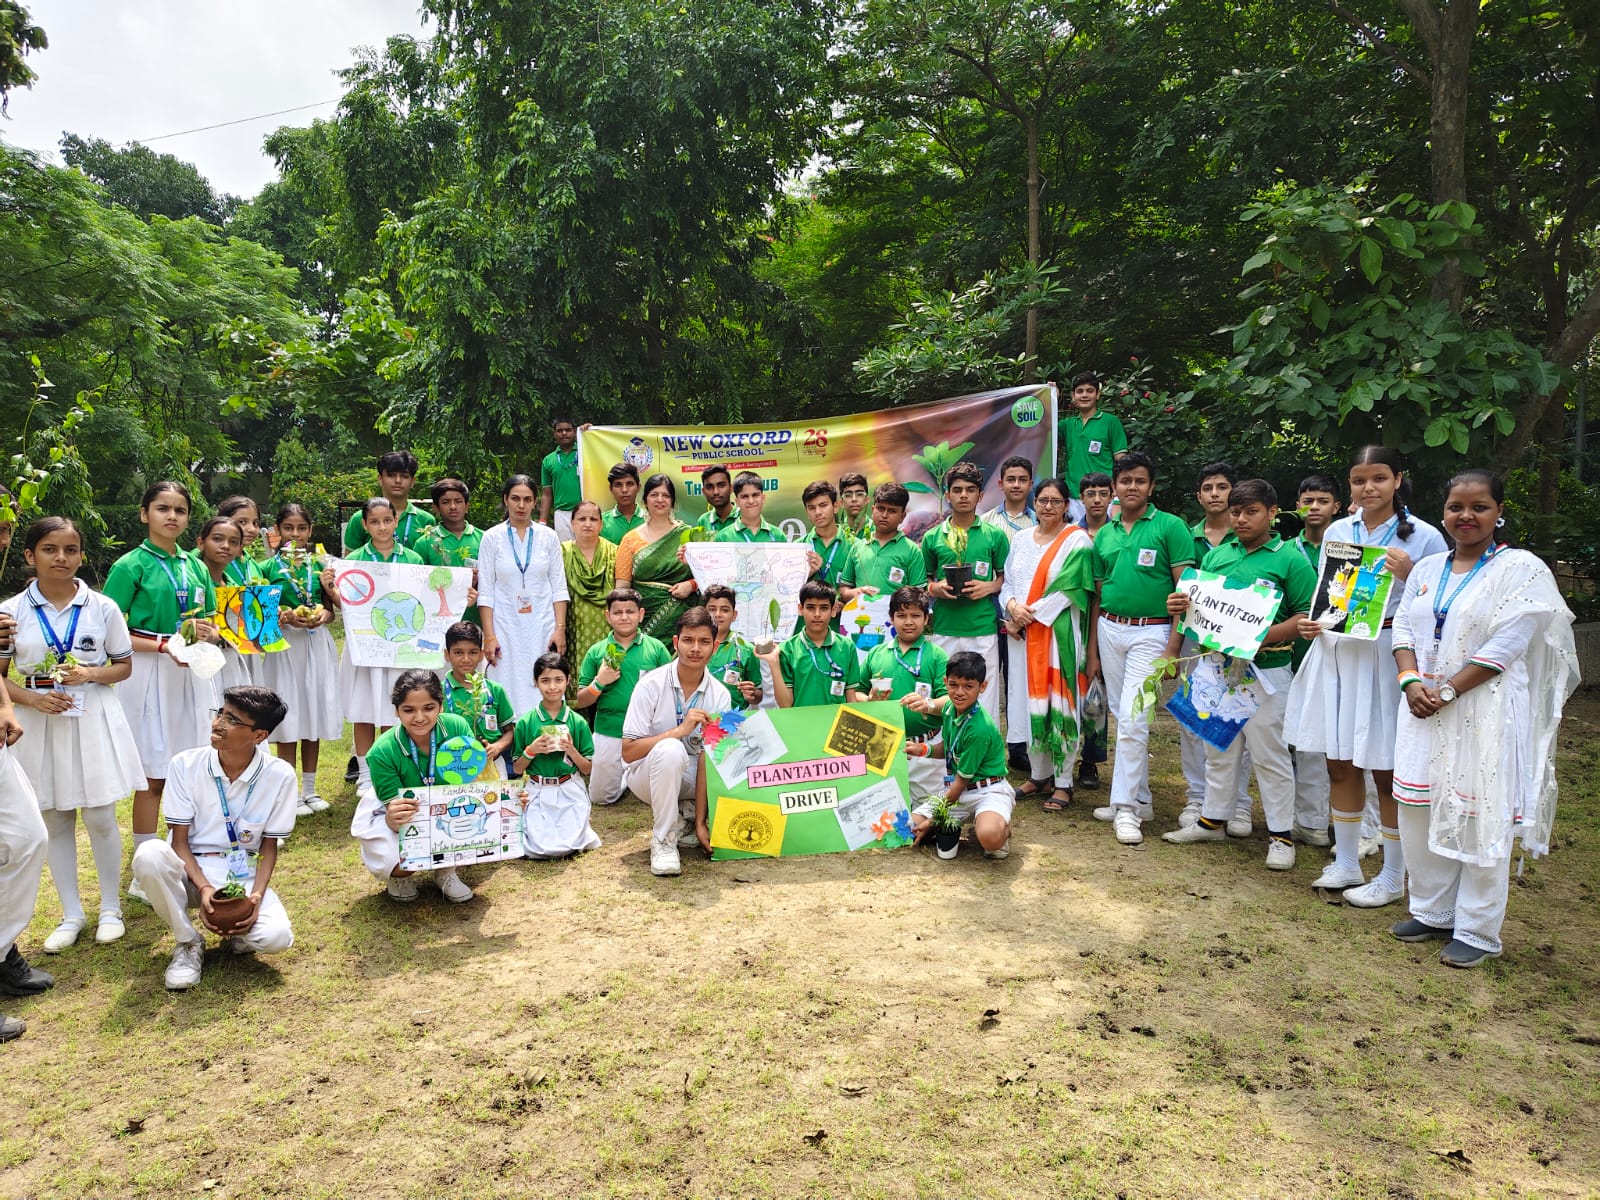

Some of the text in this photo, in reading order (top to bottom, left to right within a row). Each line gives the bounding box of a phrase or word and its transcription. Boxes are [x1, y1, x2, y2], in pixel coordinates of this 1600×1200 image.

[1016, 401, 1038, 412] SAVE
[1017, 411, 1039, 423] SOIL
[662, 430, 792, 452] NEW OXFORD
[803, 429, 828, 448] 28
[692, 448, 765, 460] PUBLIC SCHOOL
[685, 479, 779, 496] TH UB
[1189, 584, 1265, 627] PLANTATION
[1194, 609, 1224, 634] DRIVE
[752, 759, 852, 784] PLANTATION
[785, 790, 833, 809] DRIVE
